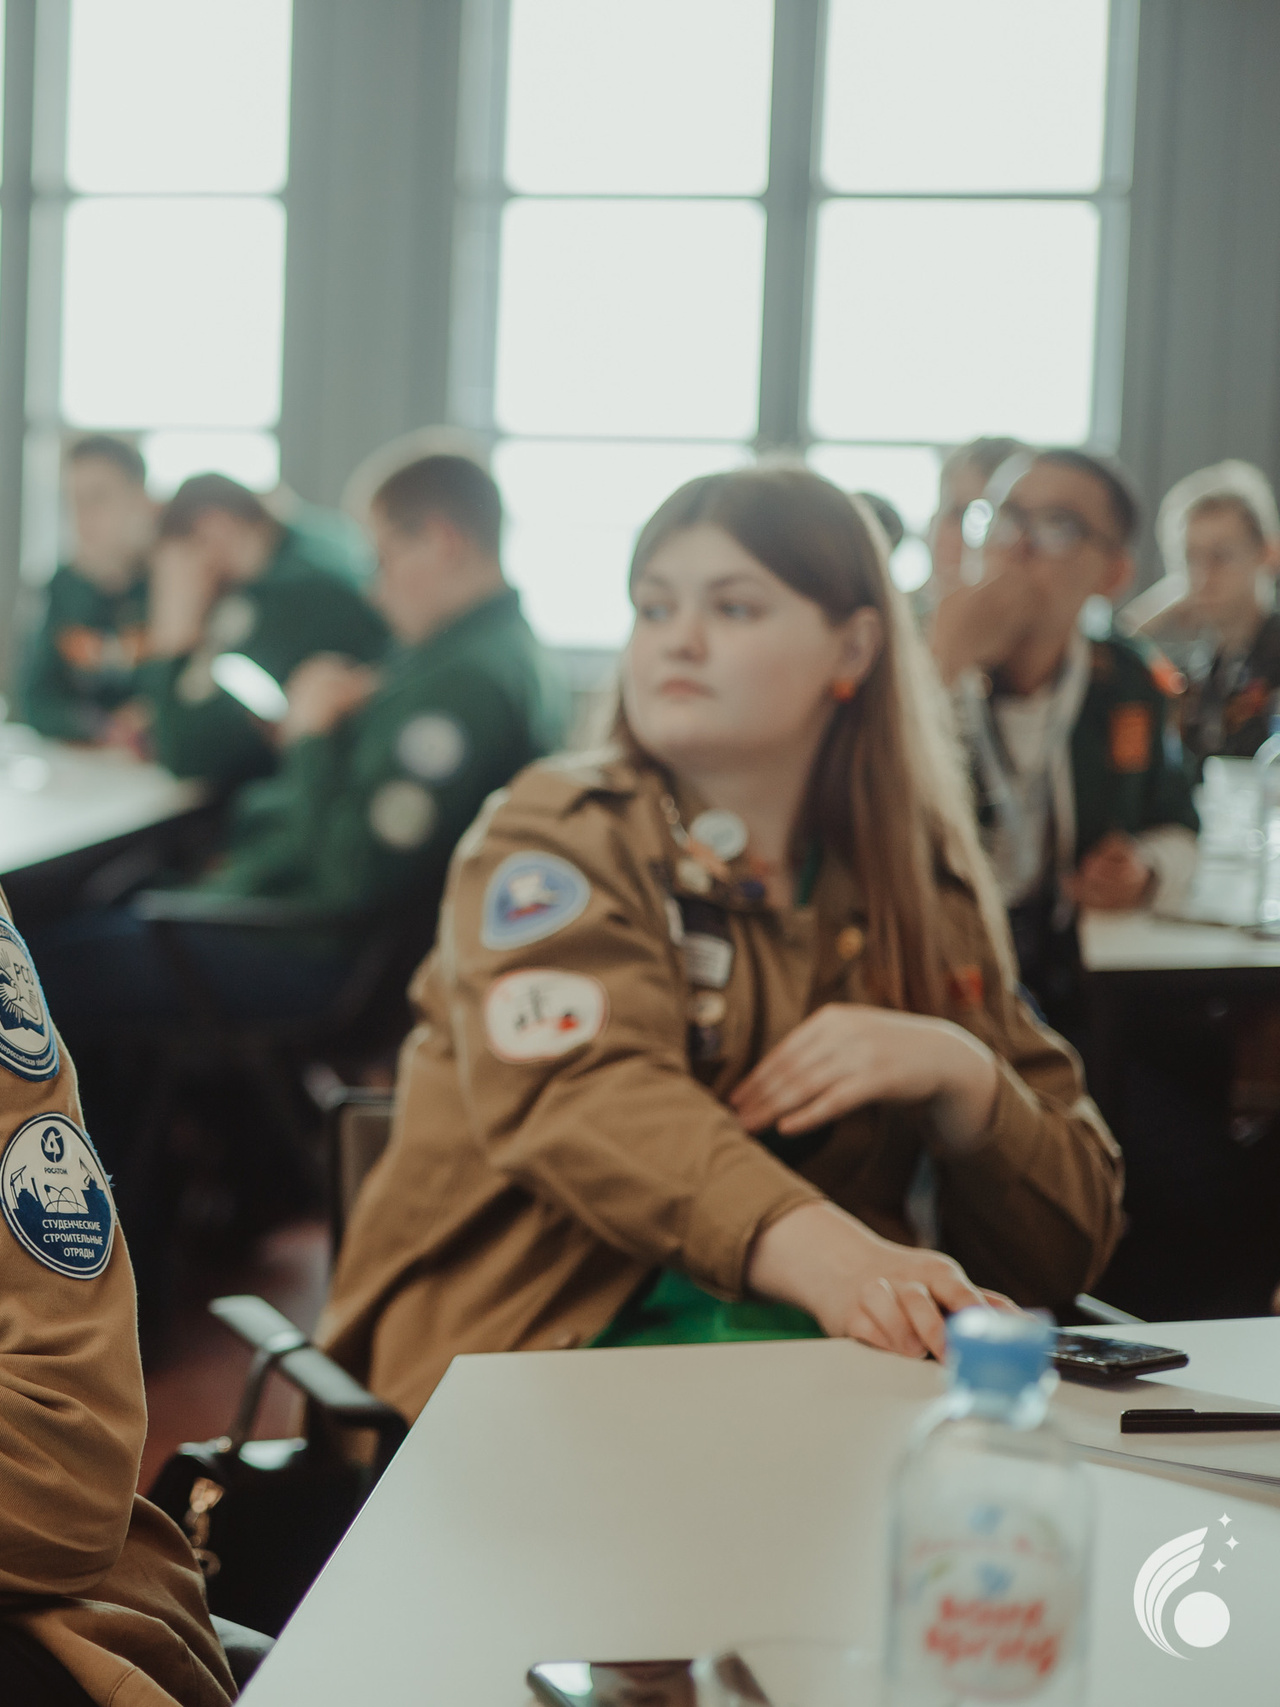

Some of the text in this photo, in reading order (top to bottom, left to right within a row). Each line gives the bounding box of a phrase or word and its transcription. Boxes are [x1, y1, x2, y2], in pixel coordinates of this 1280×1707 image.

[44, 1166, 69, 1175] РОСАТОМ
[42, 1219, 102, 1232] СТУДЕНЧЕСКИЕ
[43, 1233, 104, 1246] СТРОИТЕЛЬНЫЕ
[64, 1247, 95, 1260] ОТРЯДЫ
